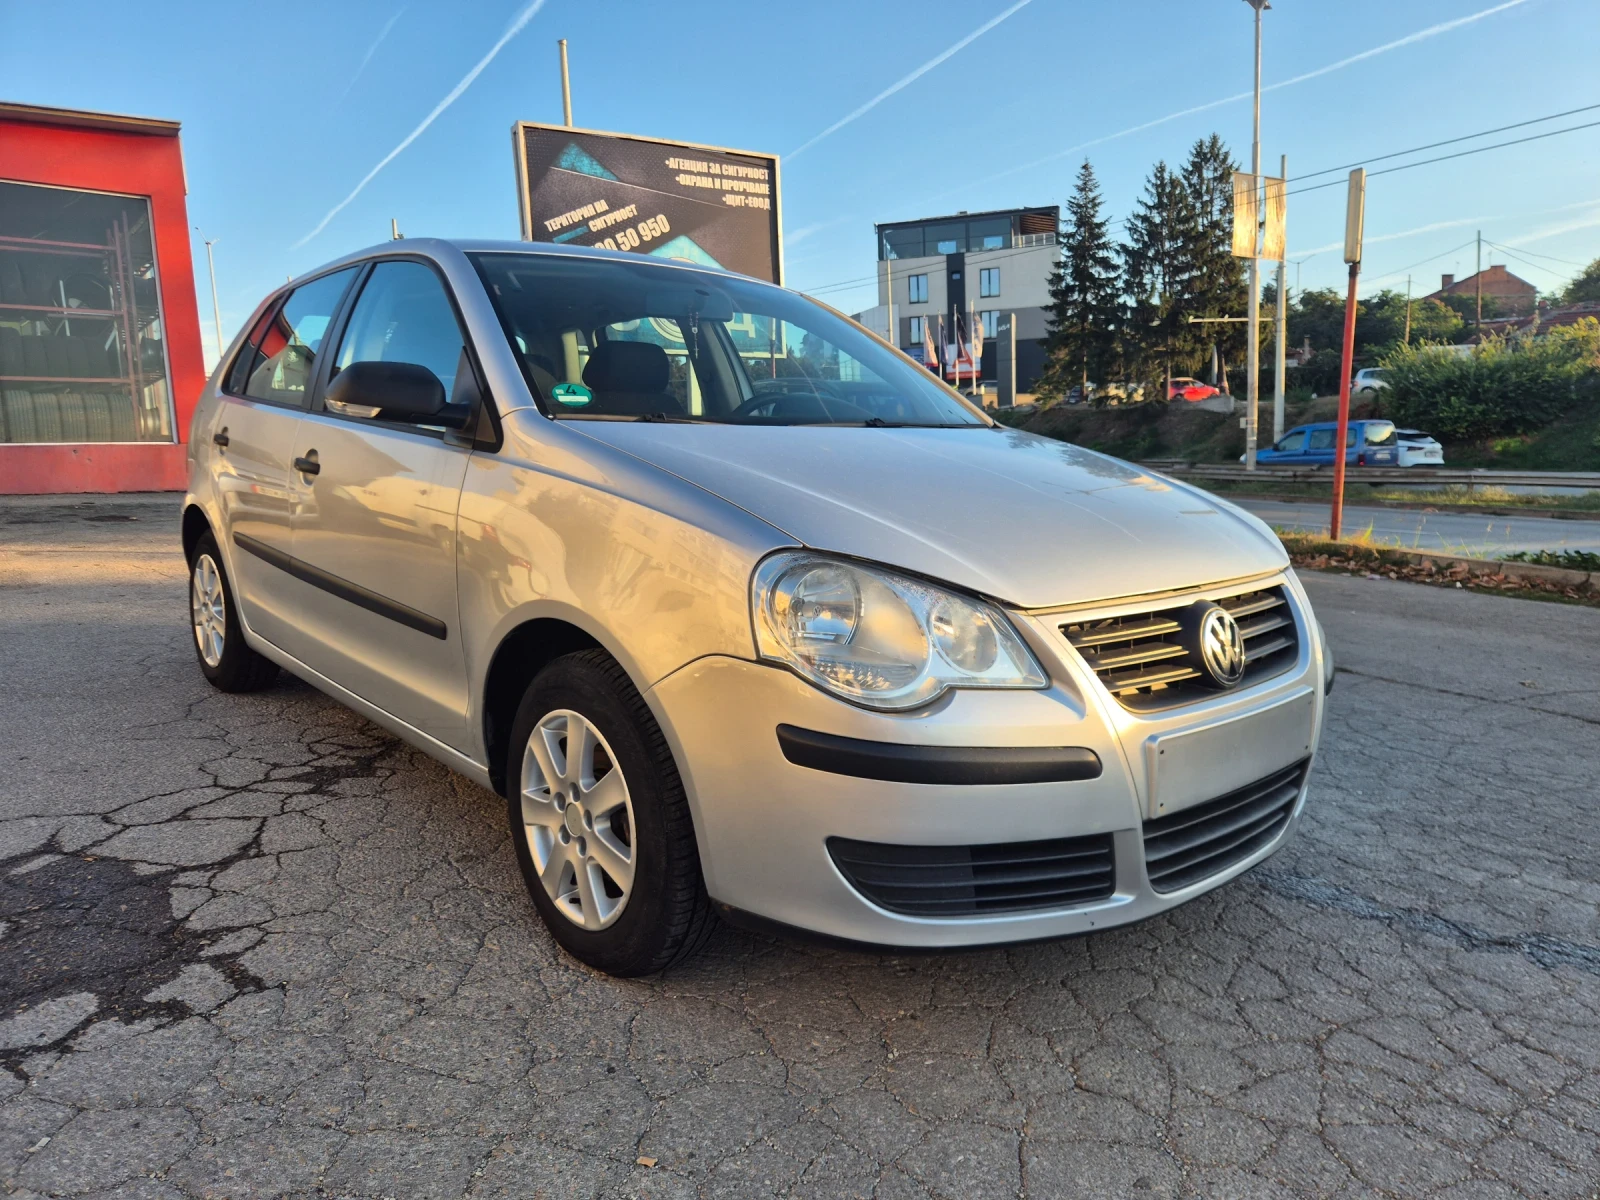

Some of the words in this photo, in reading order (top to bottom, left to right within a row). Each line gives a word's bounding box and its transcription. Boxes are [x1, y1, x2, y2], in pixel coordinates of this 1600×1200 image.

[709, 163, 721, 174] ЗА
[722, 165, 769, 180] СИГУРНОСТ
[714, 178, 721, 189] И
[722, 179, 770, 194] ПРОУЧВАНЕ
[544, 203, 595, 232] ТЕРИТОРИЯ
[593, 199, 609, 213] НА
[588, 204, 638, 232] СИГУРНОСТ
[615, 228, 640, 251] 50
[638, 214, 670, 242] 950
